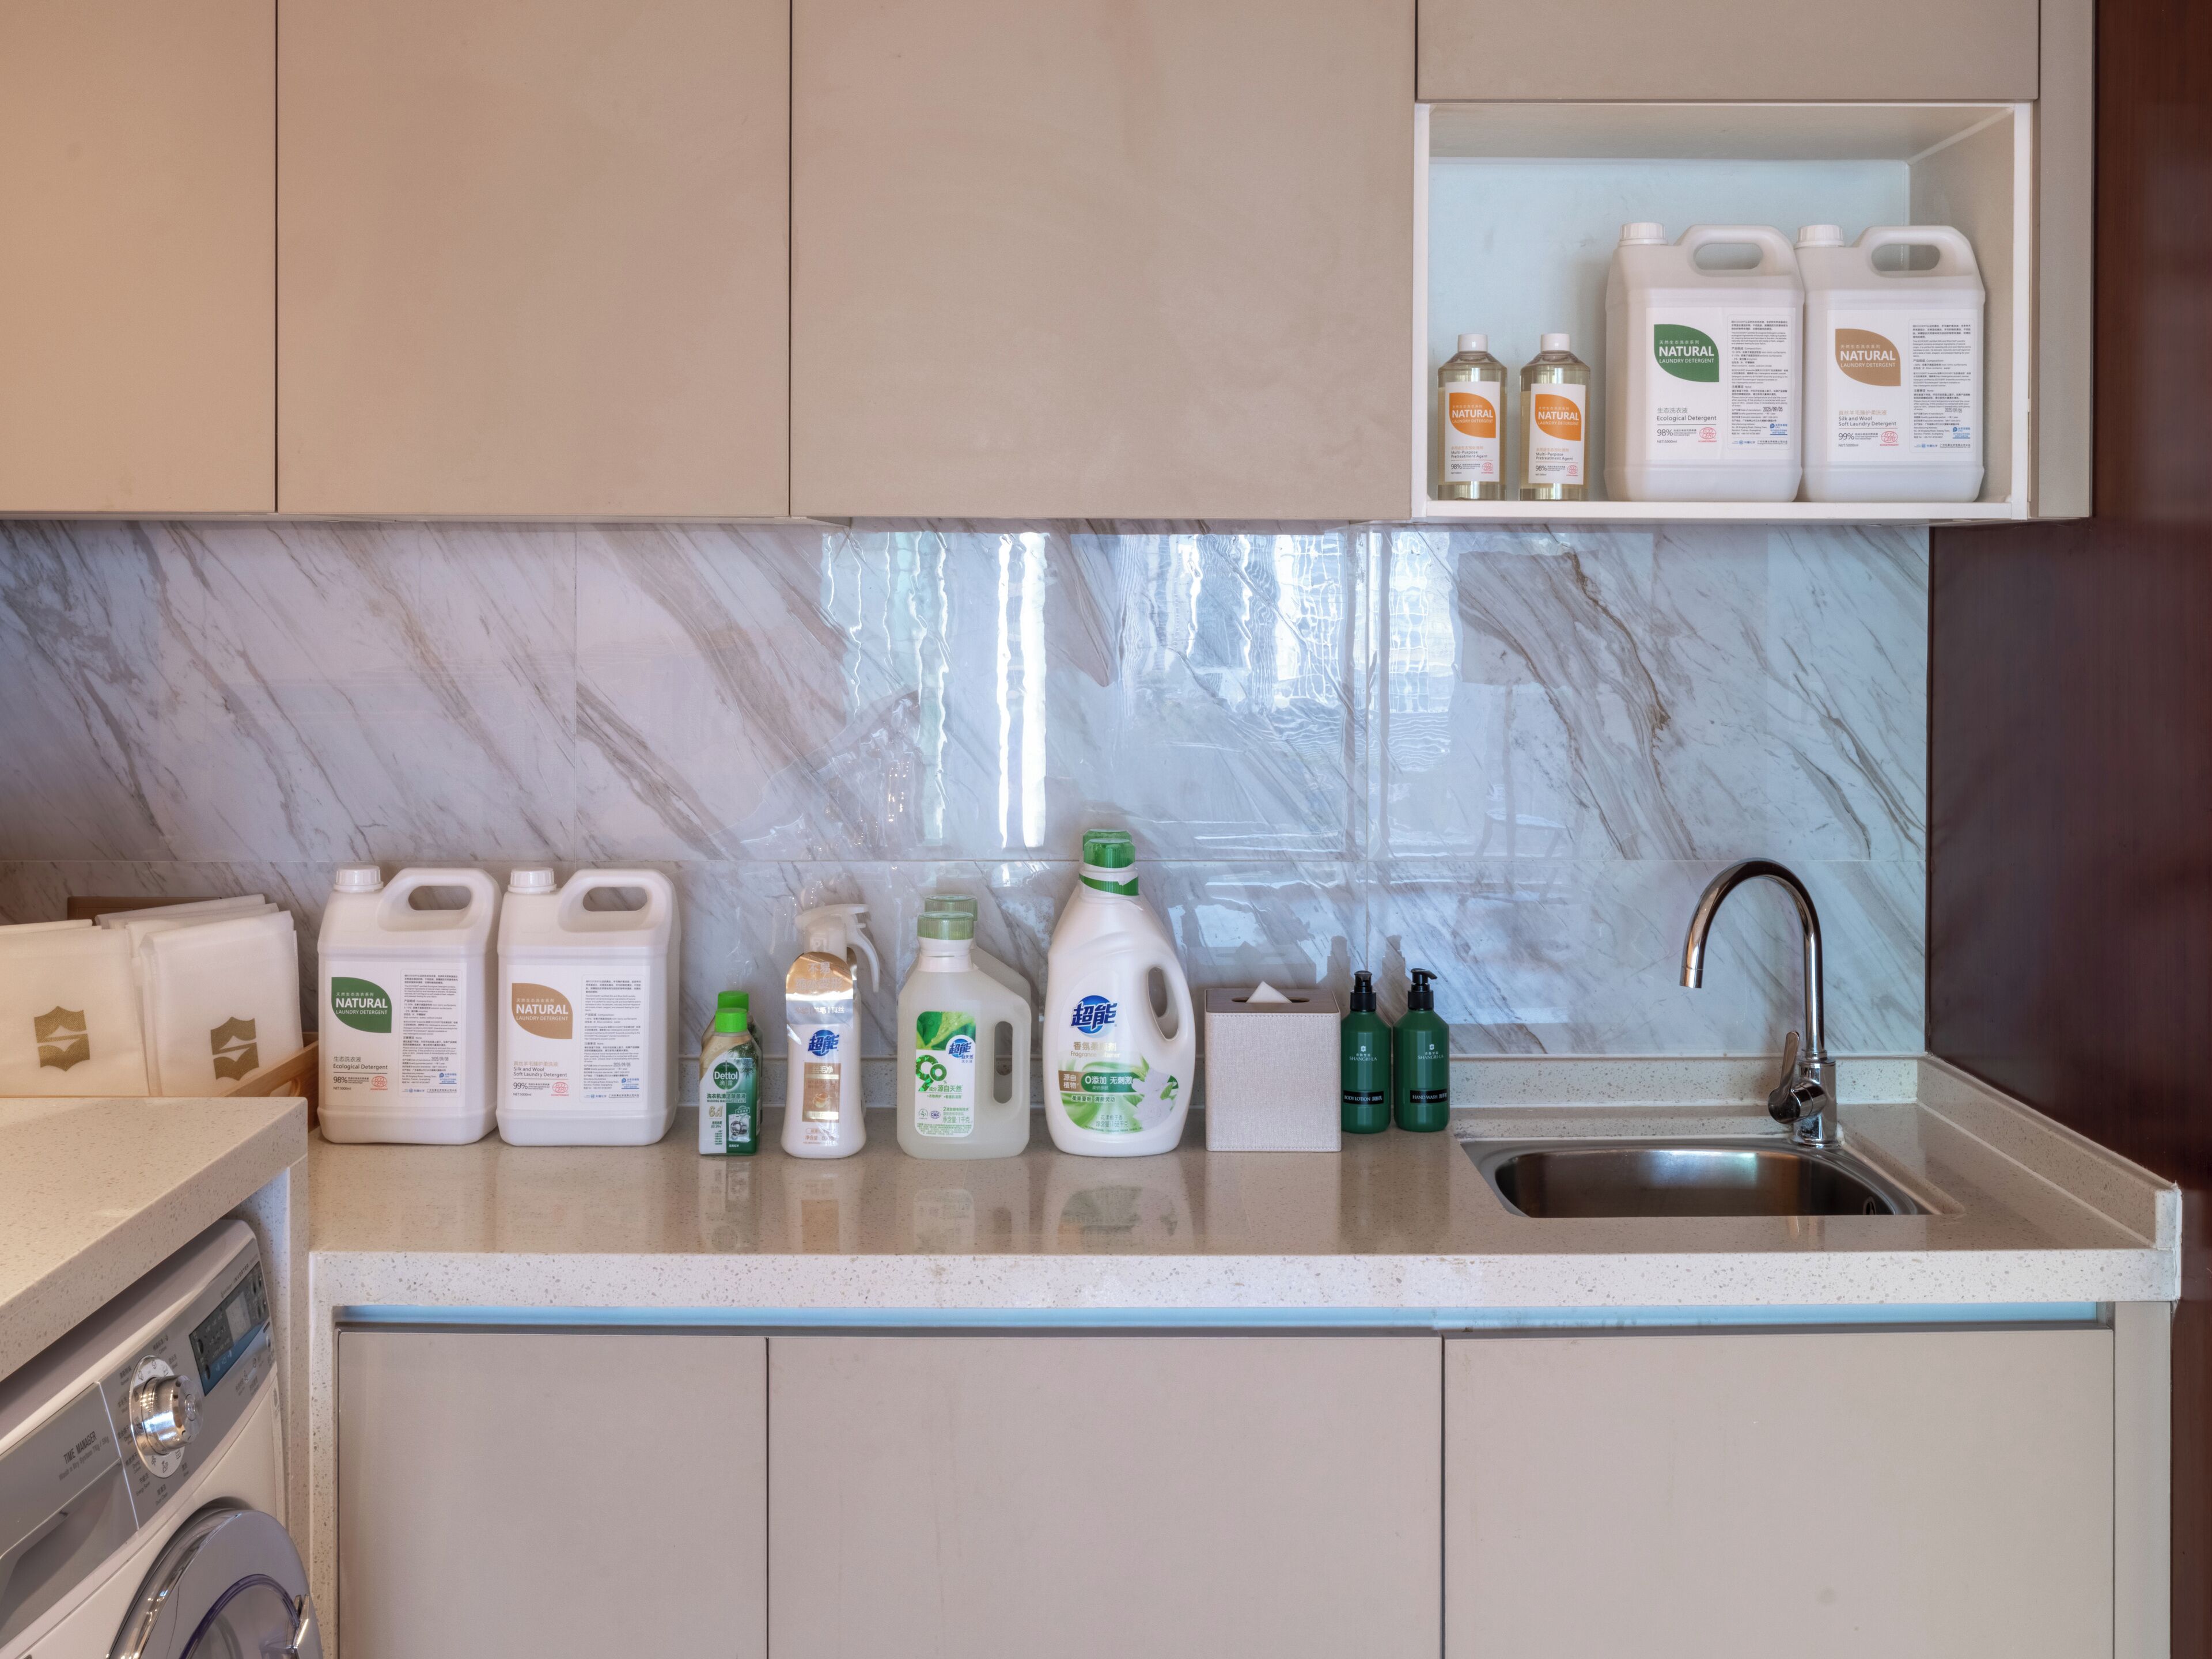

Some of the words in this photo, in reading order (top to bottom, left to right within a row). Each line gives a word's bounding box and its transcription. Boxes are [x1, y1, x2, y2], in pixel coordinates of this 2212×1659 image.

[1658, 346, 1714, 357] NATURAL
[1840, 350, 1896, 361] NATURAL
[1452, 410, 1493, 418] NATURAL
[1538, 411, 1579, 421] NATURAL
[808, 961, 830, 975] 不易
[796, 977, 843, 991] 缩水变形
[336, 998, 388, 1009] NATURAL
[516, 1004, 569, 1014] NATURAL
[1070, 1002, 1118, 1030] 超能
[808, 1033, 839, 1053] 超能
[948, 1041, 972, 1055] 超能
[714, 1071, 738, 1080] Dettol
[1063, 1074, 1077, 1082] 源自
[1085, 1076, 1107, 1085] 0添加
[1109, 1075, 1132, 1085] 无刺激
[63, 1448, 76, 1464] TIME
[75, 1431, 97, 1455] MANAGER
